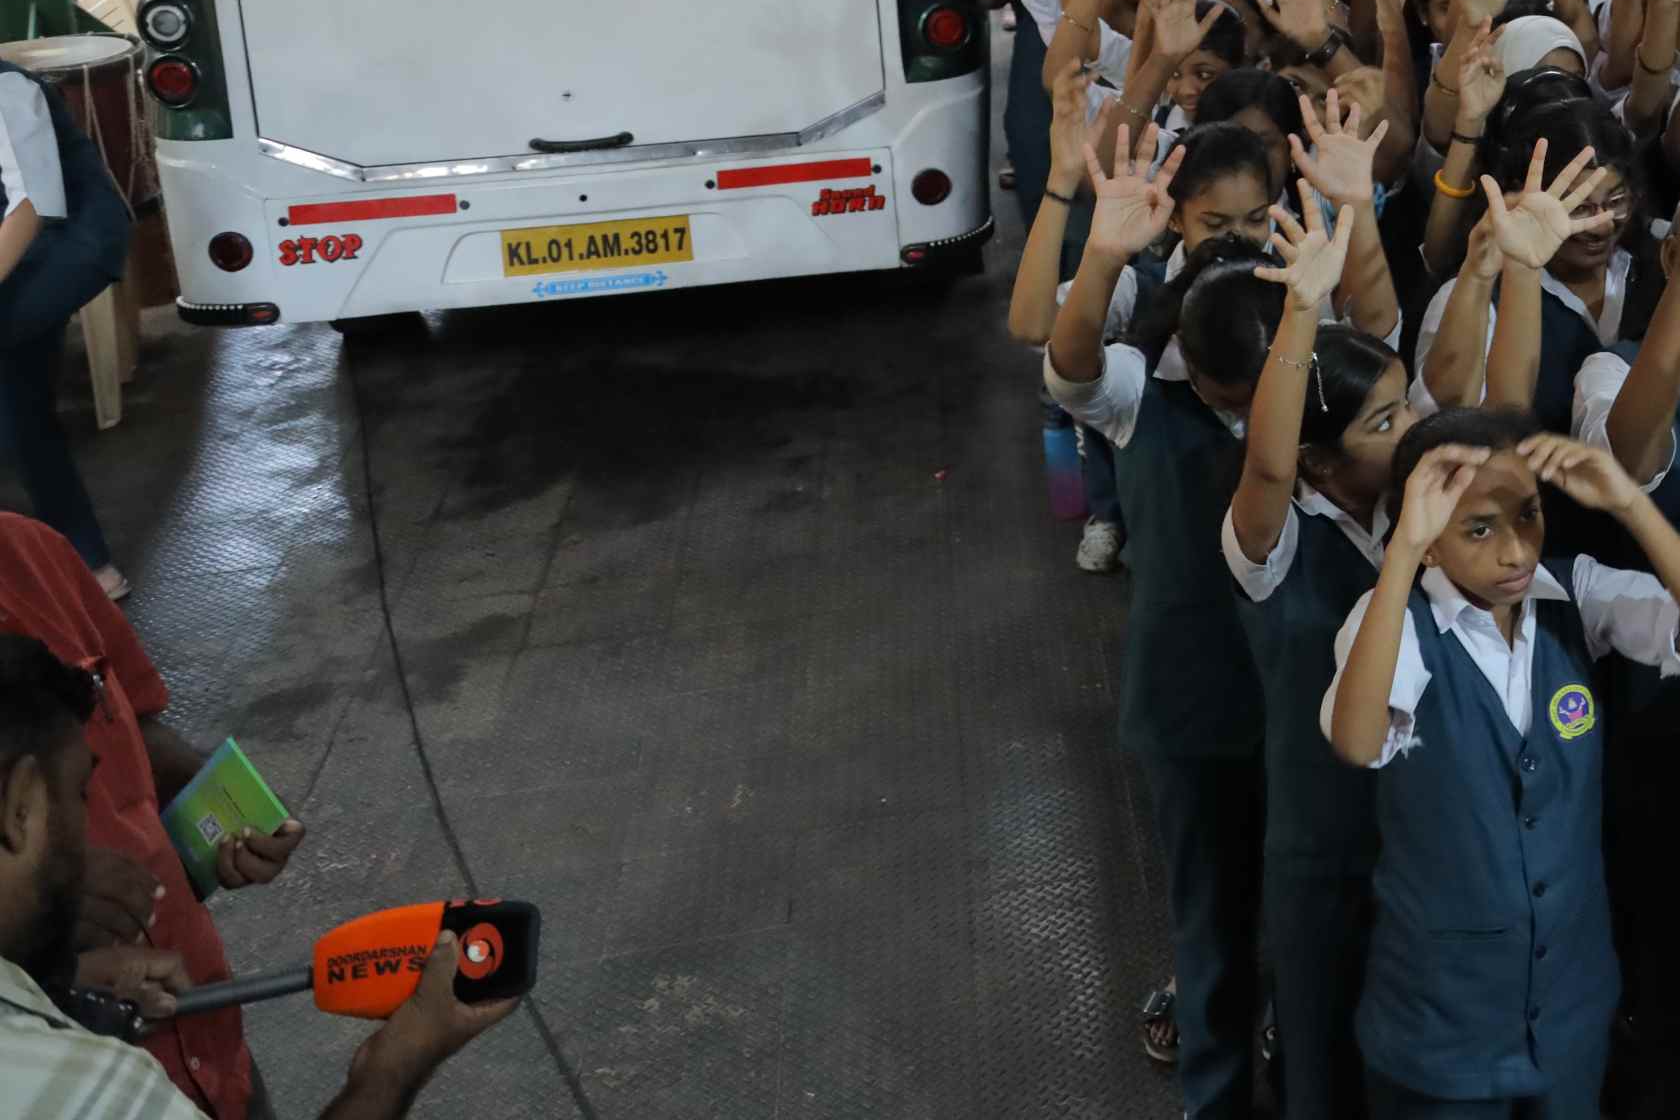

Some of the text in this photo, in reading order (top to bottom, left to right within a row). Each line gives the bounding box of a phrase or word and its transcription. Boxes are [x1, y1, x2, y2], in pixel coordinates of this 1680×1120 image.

[278, 233, 364, 266] STOP
[507, 227, 687, 267] KL.01.AM.3817
[327, 957, 427, 984] NEWS
